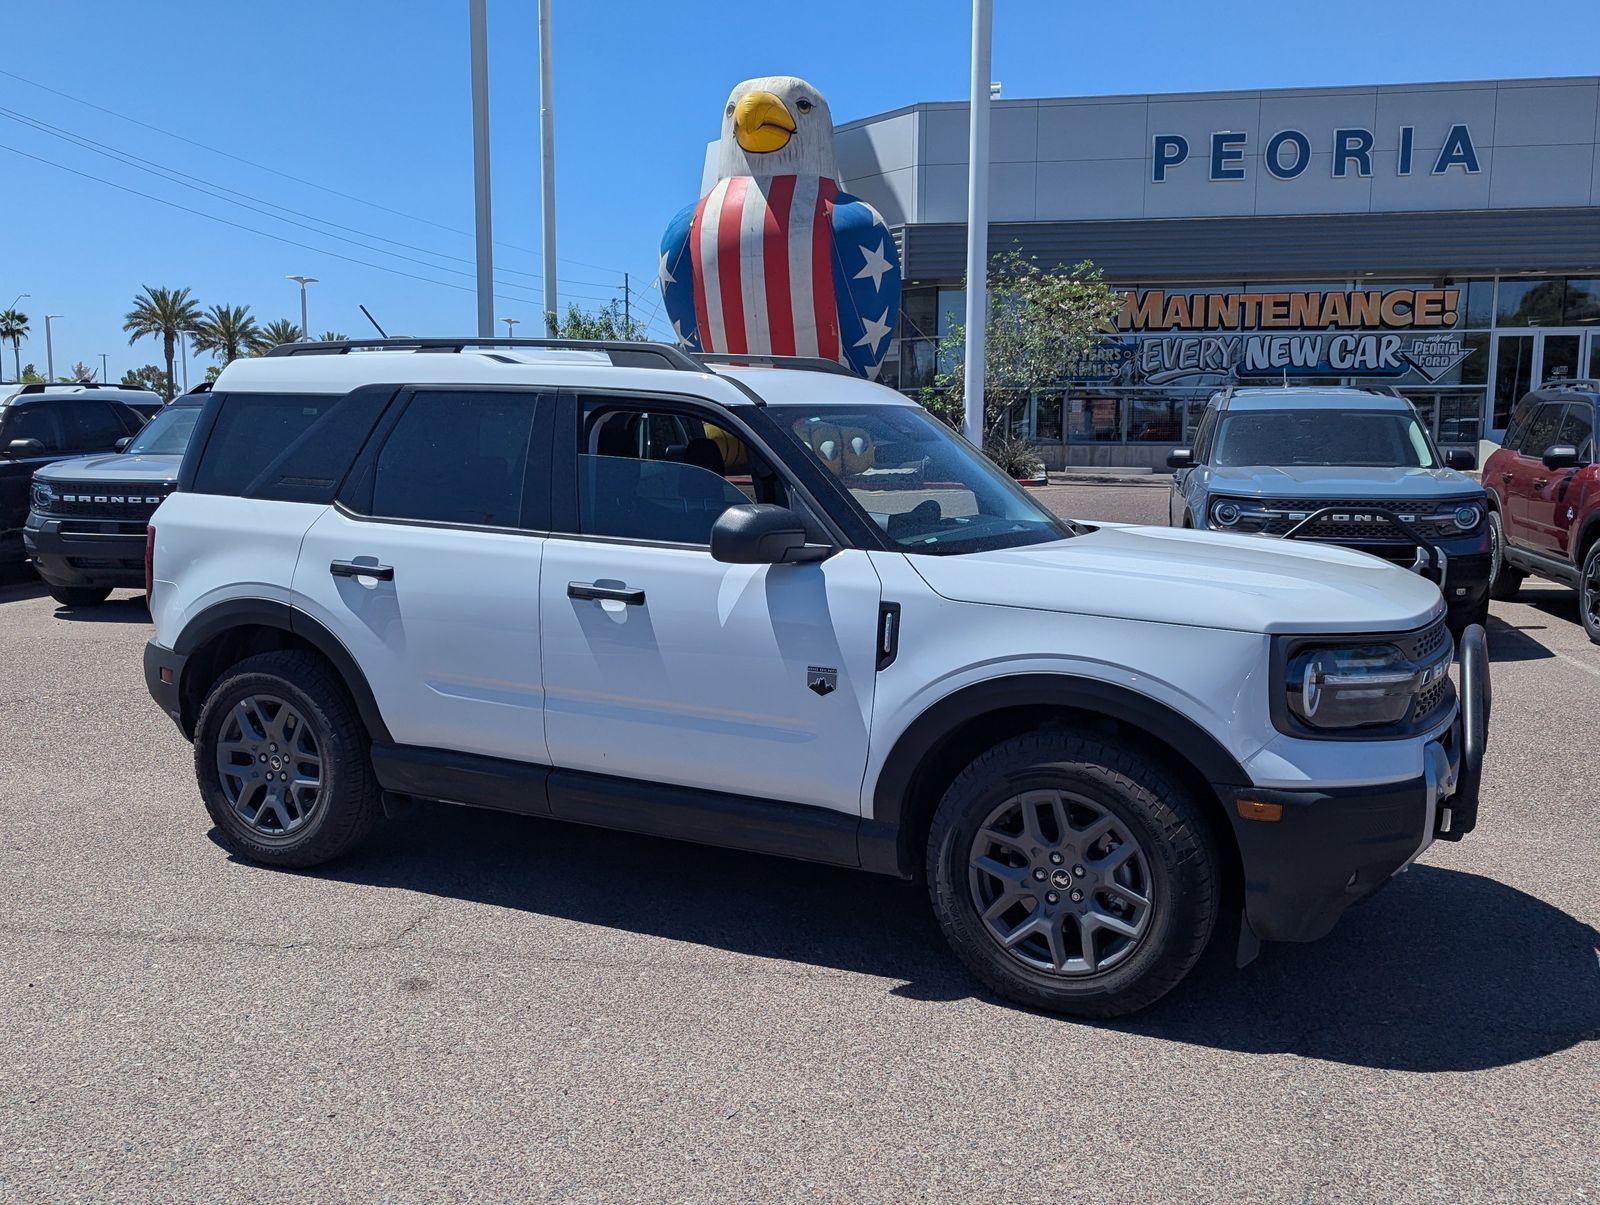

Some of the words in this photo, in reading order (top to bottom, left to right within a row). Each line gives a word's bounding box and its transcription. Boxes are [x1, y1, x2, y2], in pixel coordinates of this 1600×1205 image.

[1152, 124, 1482, 183] PEORIA
[1116, 288, 1460, 331] MAINTENANCE!
[1141, 336, 1242, 373] EVERY
[1245, 335, 1323, 371] NEW
[1329, 334, 1402, 370] CAR
[1413, 341, 1459, 356] PEORIA
[1418, 356, 1450, 367] FORD
[63, 495, 160, 504] BRONCO
[1288, 513, 1416, 522] BONO
